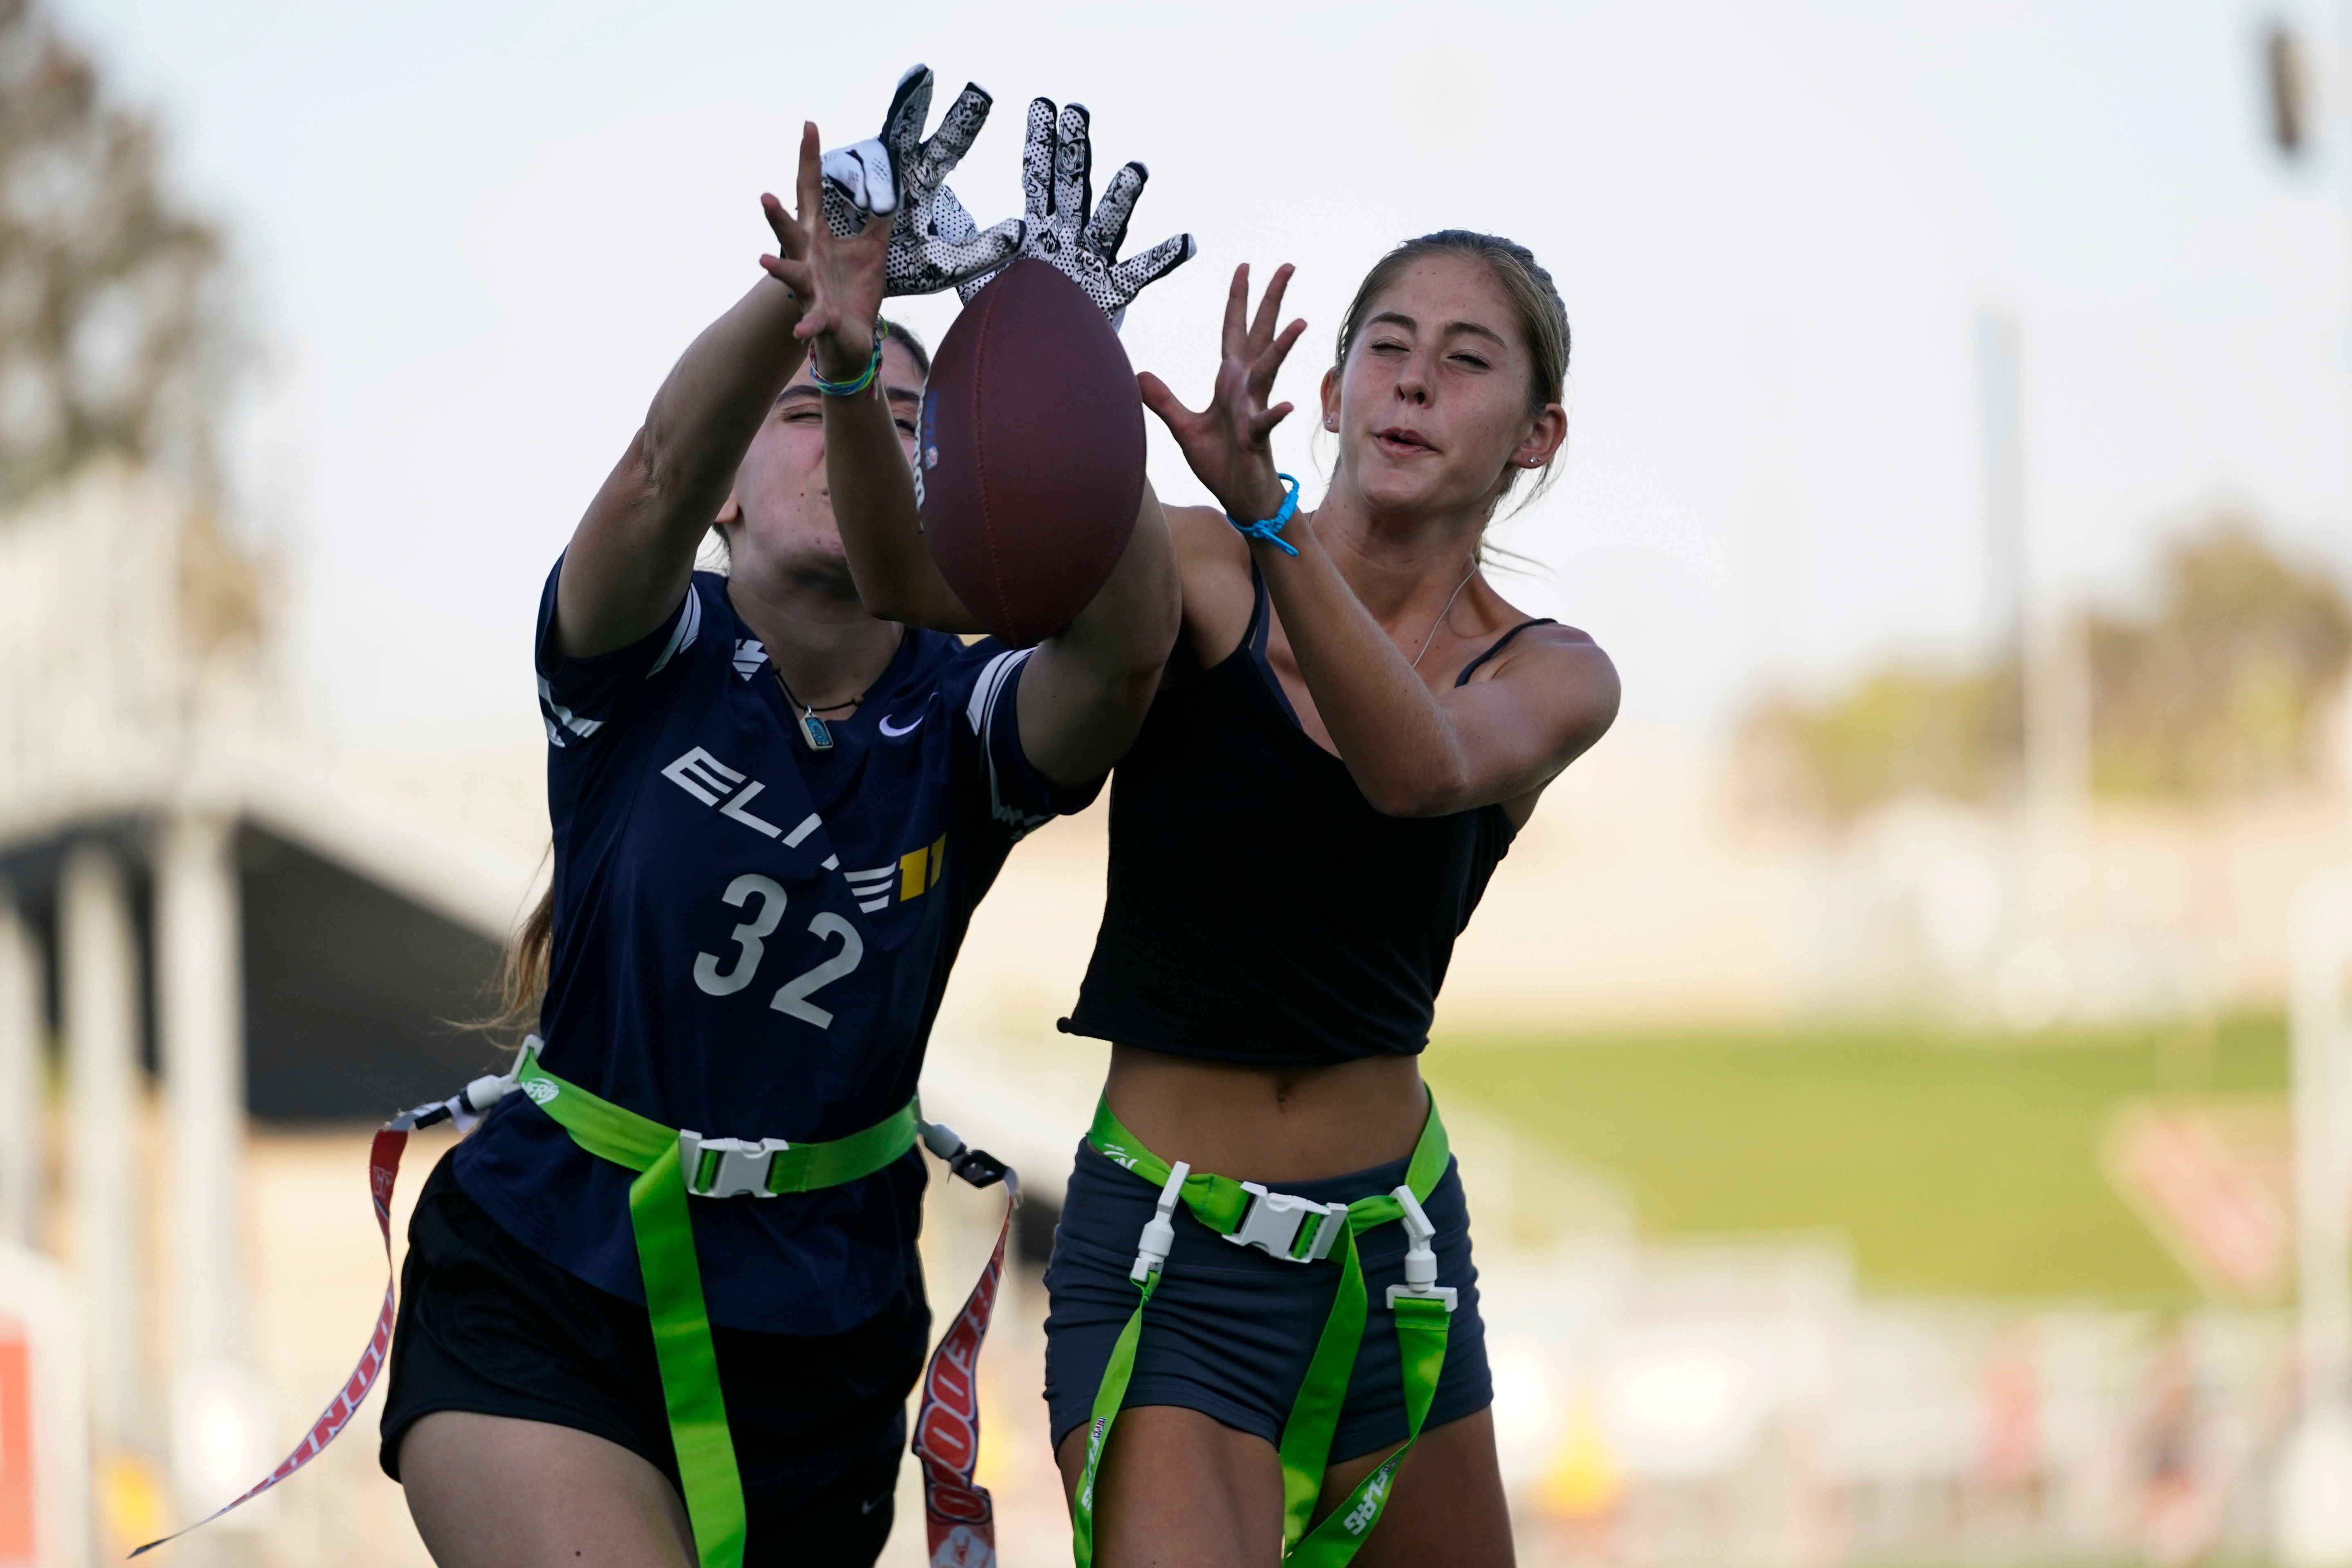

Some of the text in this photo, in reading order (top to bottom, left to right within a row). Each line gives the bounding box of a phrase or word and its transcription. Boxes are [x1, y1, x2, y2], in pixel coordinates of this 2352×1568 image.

[661, 746, 896, 914] ELIE
[693, 873, 863, 1030] 32
[1343, 1470, 1389, 1536] FLAG
